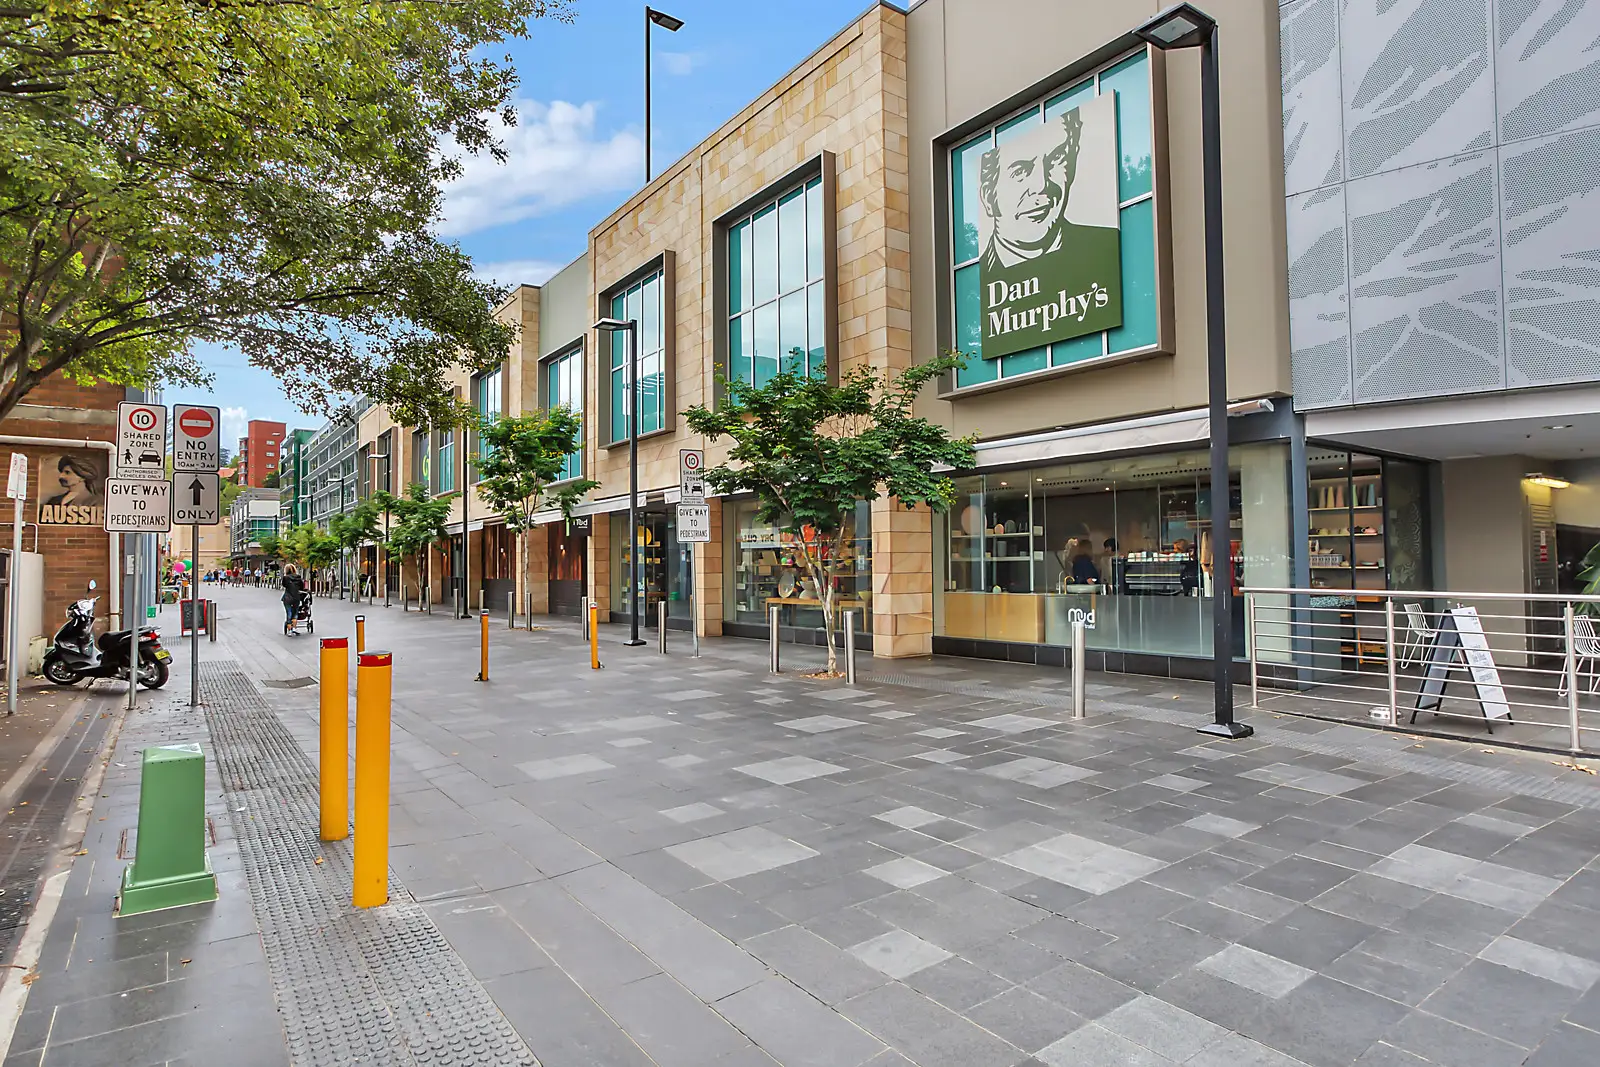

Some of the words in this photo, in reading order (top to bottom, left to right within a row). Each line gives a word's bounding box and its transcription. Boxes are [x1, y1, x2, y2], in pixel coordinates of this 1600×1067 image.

[987, 277, 1041, 309] Dan
[988, 282, 1109, 338] Murphy's
[136, 414, 150, 425] 10
[123, 432, 161, 441] SHARED
[186, 440, 207, 451] NO
[177, 451, 216, 461] ENTRY
[688, 457, 696, 465] 10
[111, 484, 138, 496] GIVE
[142, 485, 167, 496] WAY
[132, 500, 147, 511] TO
[41, 504, 104, 525] AUSSIE
[177, 510, 215, 519] ONLY
[679, 508, 693, 517] GIVE
[694, 509, 707, 517] WAY
[110, 514, 166, 526] PEDESTRIANS
[690, 519, 698, 527] TO
[679, 529, 708, 538] PEDESTRIANS
